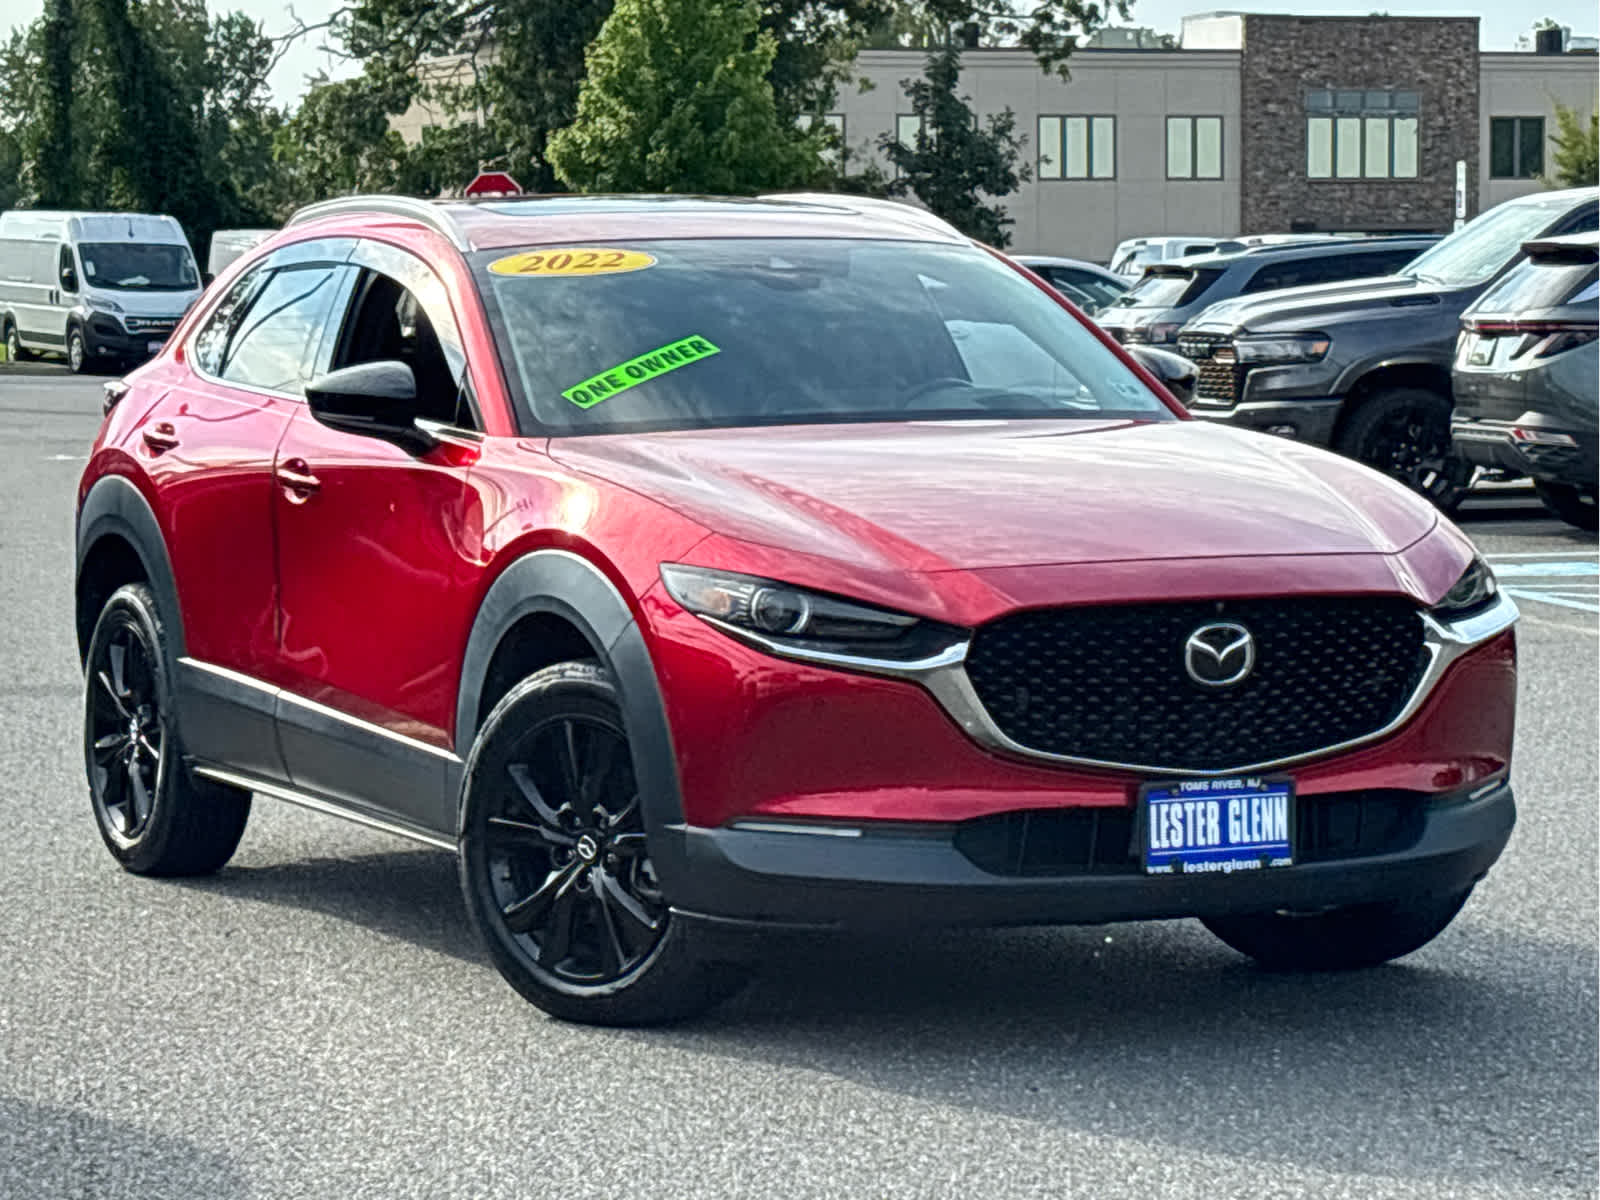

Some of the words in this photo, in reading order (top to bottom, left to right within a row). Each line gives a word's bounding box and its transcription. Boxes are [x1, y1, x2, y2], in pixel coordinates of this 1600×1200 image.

[519, 252, 626, 273] 2022
[571, 373, 627, 404] ONE
[625, 339, 712, 379] OWNER
[1179, 781, 1209, 792] TOMS
[1150, 800, 1220, 849] LESTER
[1228, 796, 1288, 844] GLENN
[1183, 859, 1262, 874] lesterglenn
